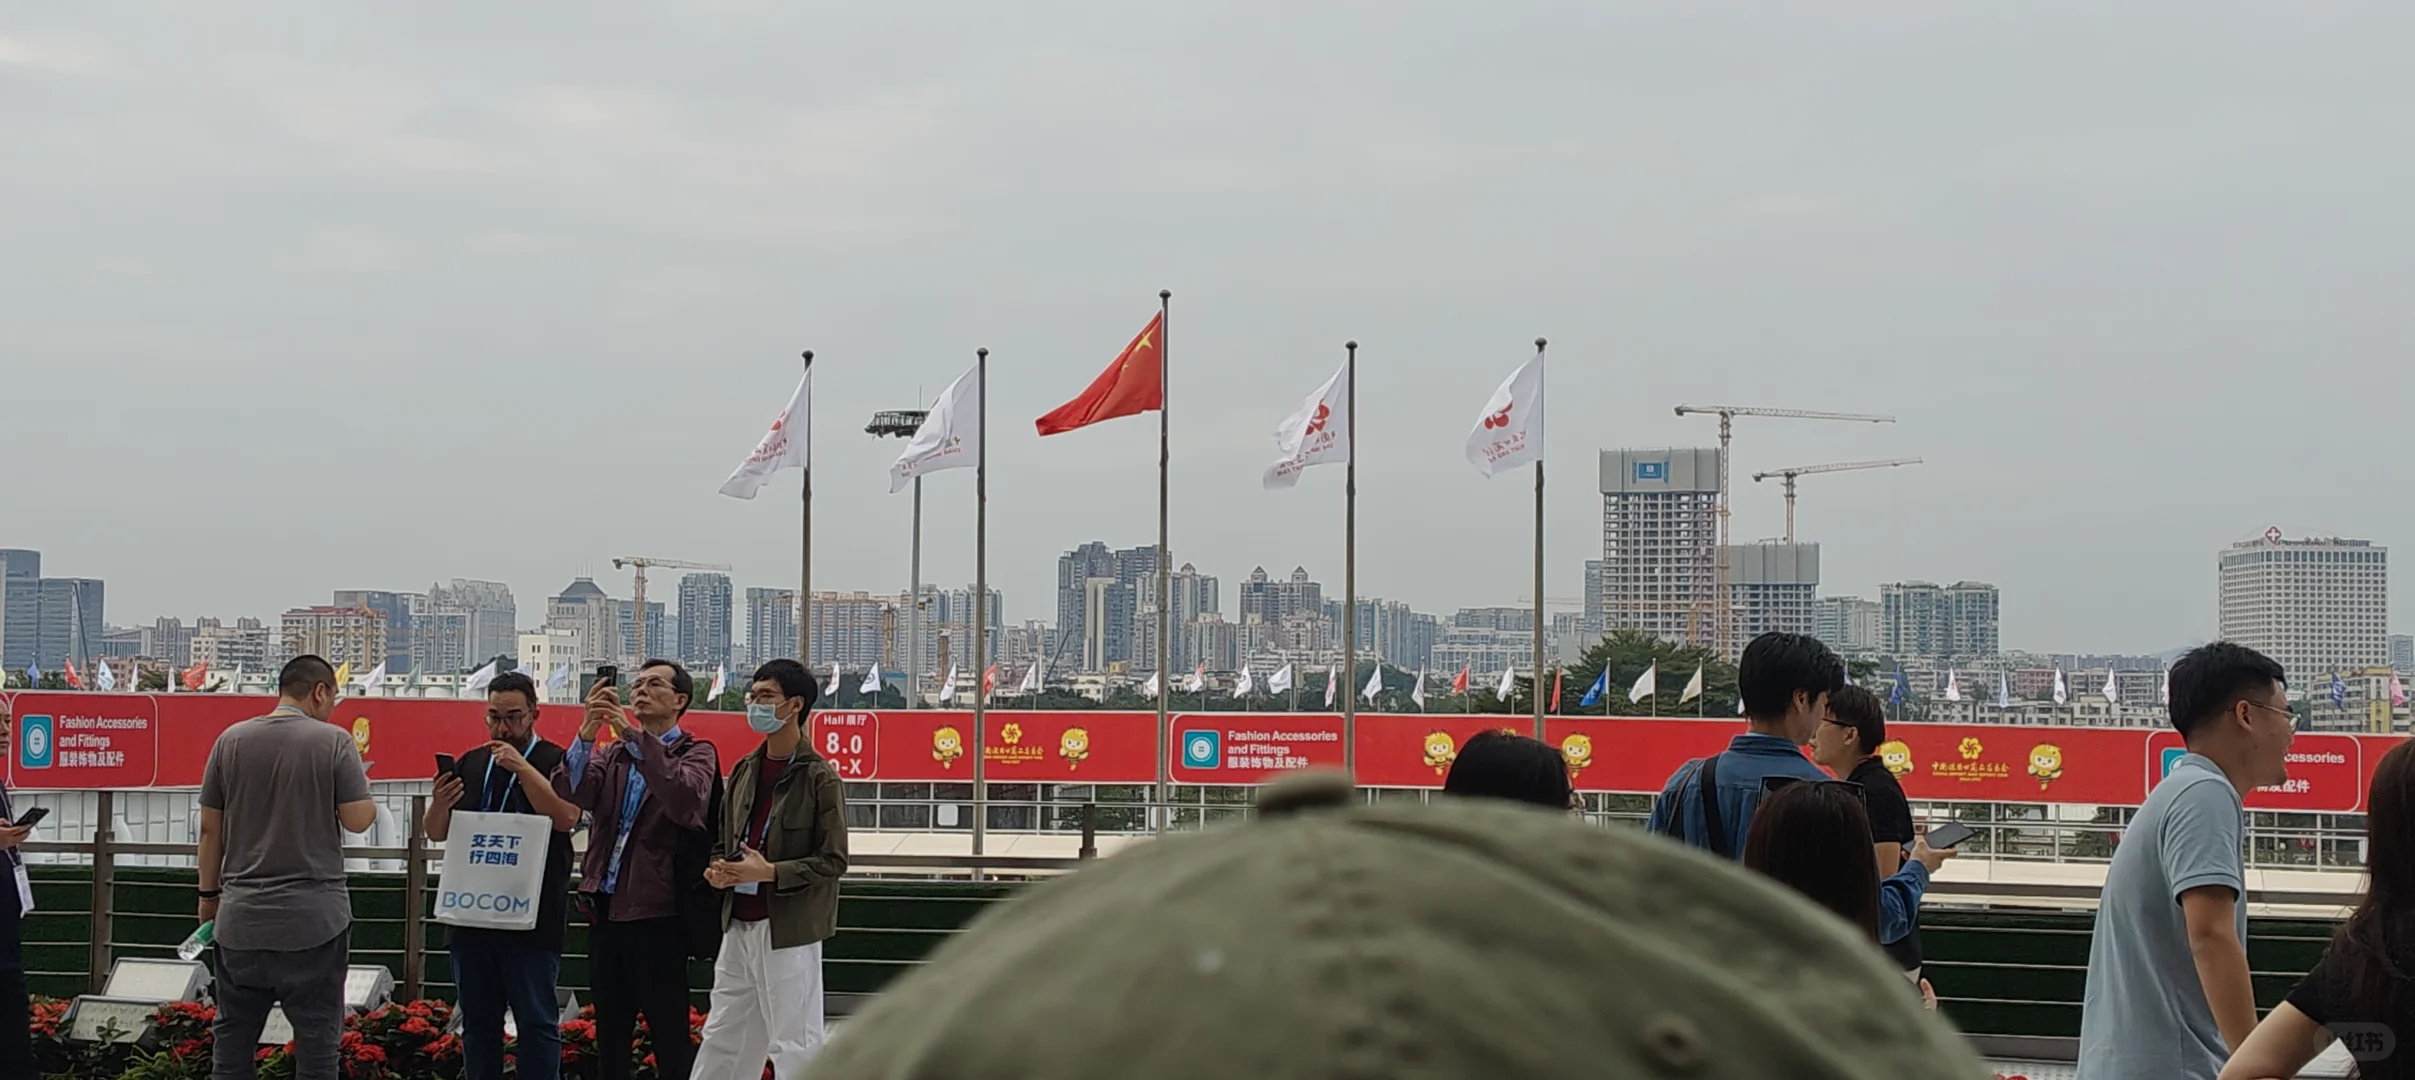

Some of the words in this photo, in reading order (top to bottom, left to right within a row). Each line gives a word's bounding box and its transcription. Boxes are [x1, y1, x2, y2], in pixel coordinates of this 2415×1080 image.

[59, 715, 96, 729] Fashion
[97, 716, 148, 729] Accessories
[824, 714, 844, 726] Hall
[59, 735, 77, 747] and
[78, 734, 111, 750] Fittings
[826, 731, 863, 755] 8.0
[1227, 731, 1270, 742] Fashion
[1274, 731, 1338, 742] Accessories
[1227, 744, 1249, 755] and
[1250, 744, 1290, 757] Fittings
[2284, 750, 2345, 764] cessories
[59, 751, 125, 767] 服装饰物及配件
[1227, 756, 1309, 769] 服装饰物及配件
[471, 833, 523, 850] 交天下
[469, 850, 520, 867] 行四海
[442, 891, 531, 914] BOCOM
